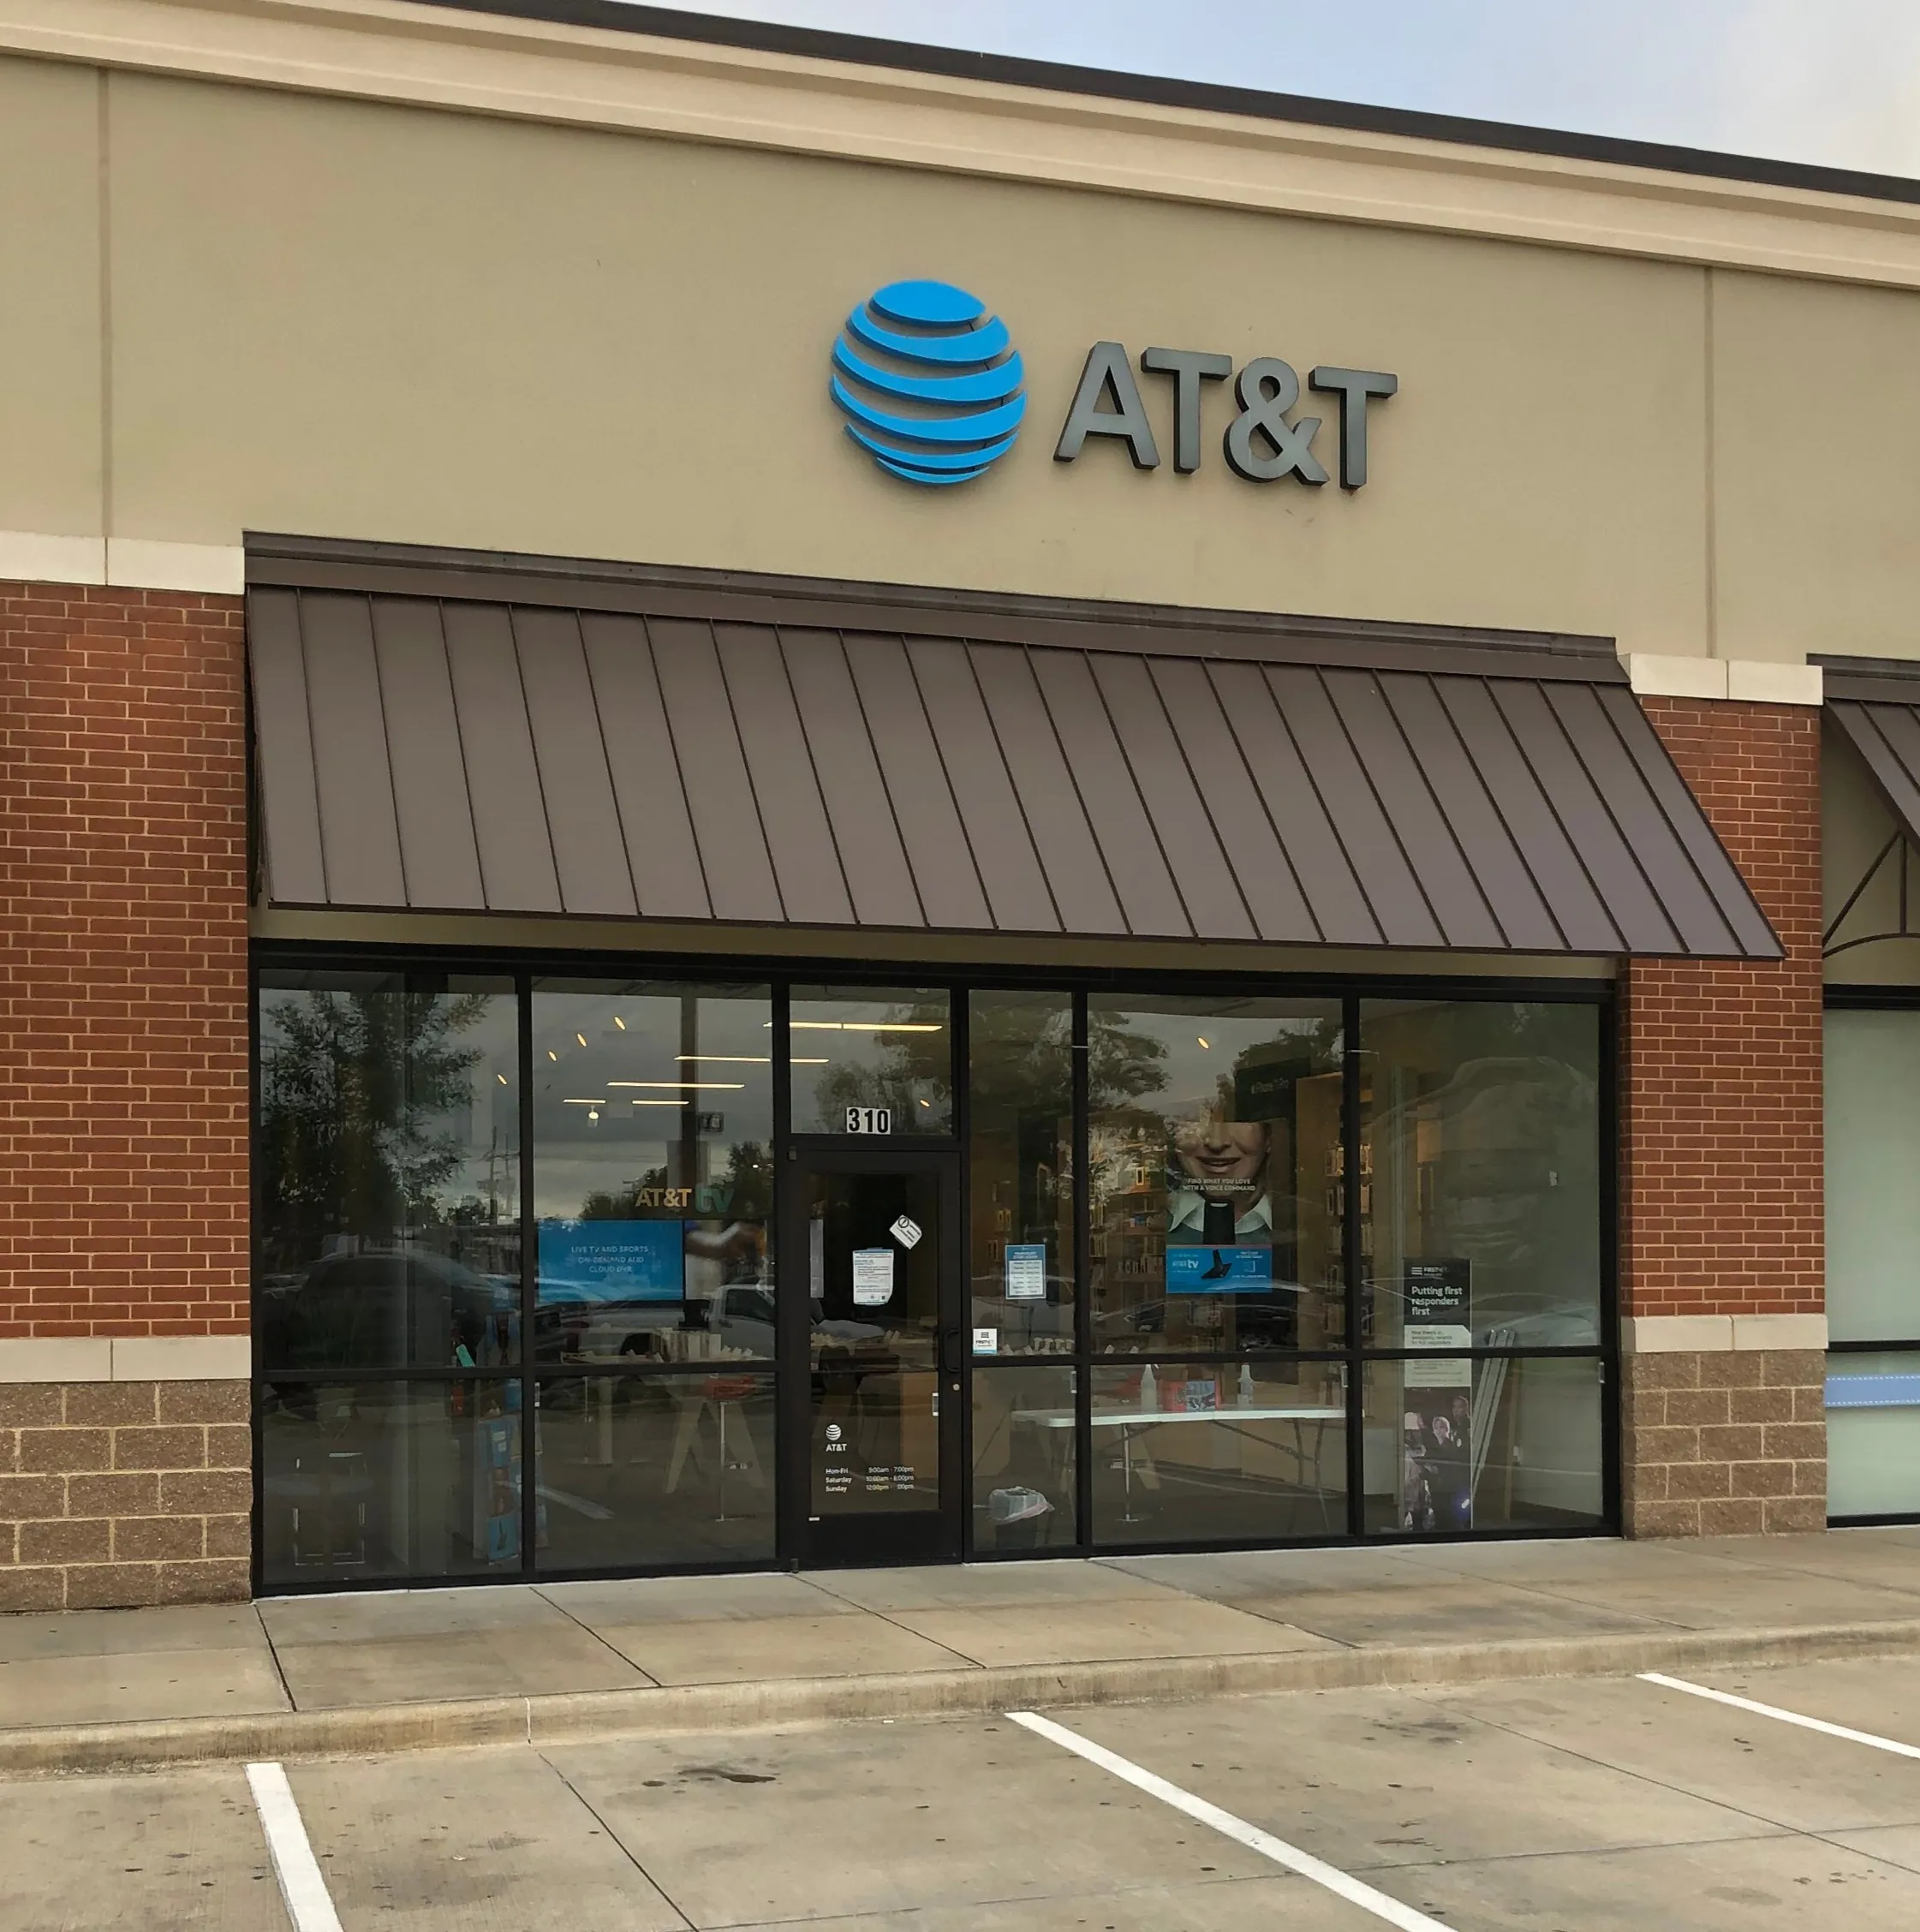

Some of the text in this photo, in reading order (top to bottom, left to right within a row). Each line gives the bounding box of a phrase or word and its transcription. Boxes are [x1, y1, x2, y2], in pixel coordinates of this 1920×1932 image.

[1052, 340, 1398, 492] AT&T
[848, 1107, 889, 1134] 310
[635, 1182, 735, 1213] AT&T tv
[1411, 1286, 1463, 1297] Putting first
[1411, 1297, 1458, 1307] responders
[1411, 1307, 1430, 1316] first
[826, 1443, 847, 1452] AT&T
